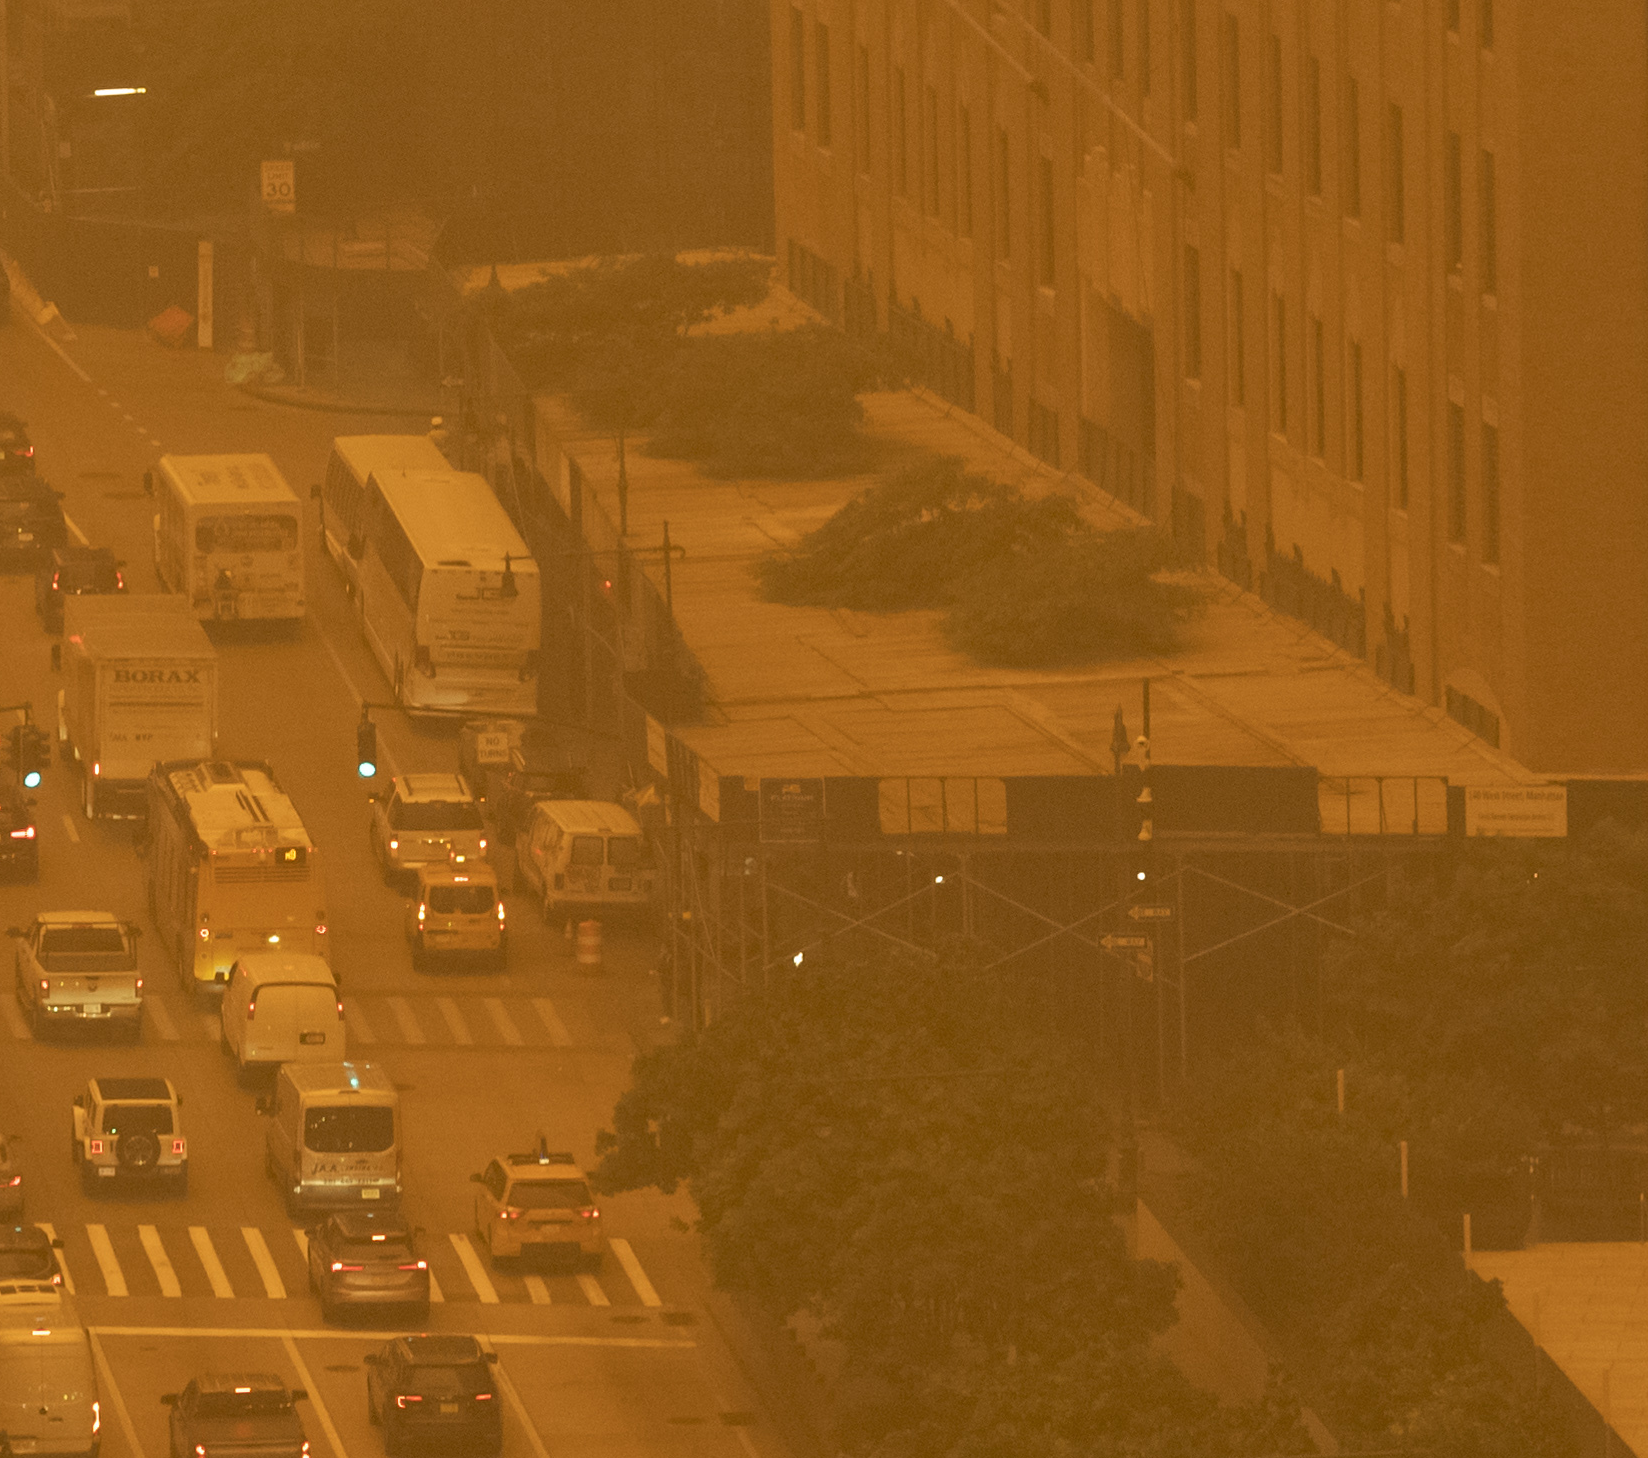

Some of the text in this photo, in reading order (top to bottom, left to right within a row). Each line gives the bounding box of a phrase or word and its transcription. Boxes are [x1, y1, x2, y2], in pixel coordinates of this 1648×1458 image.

[266, 182, 291, 198] 30
[113, 669, 200, 683] BORAX
[486, 737, 500, 746] NO
